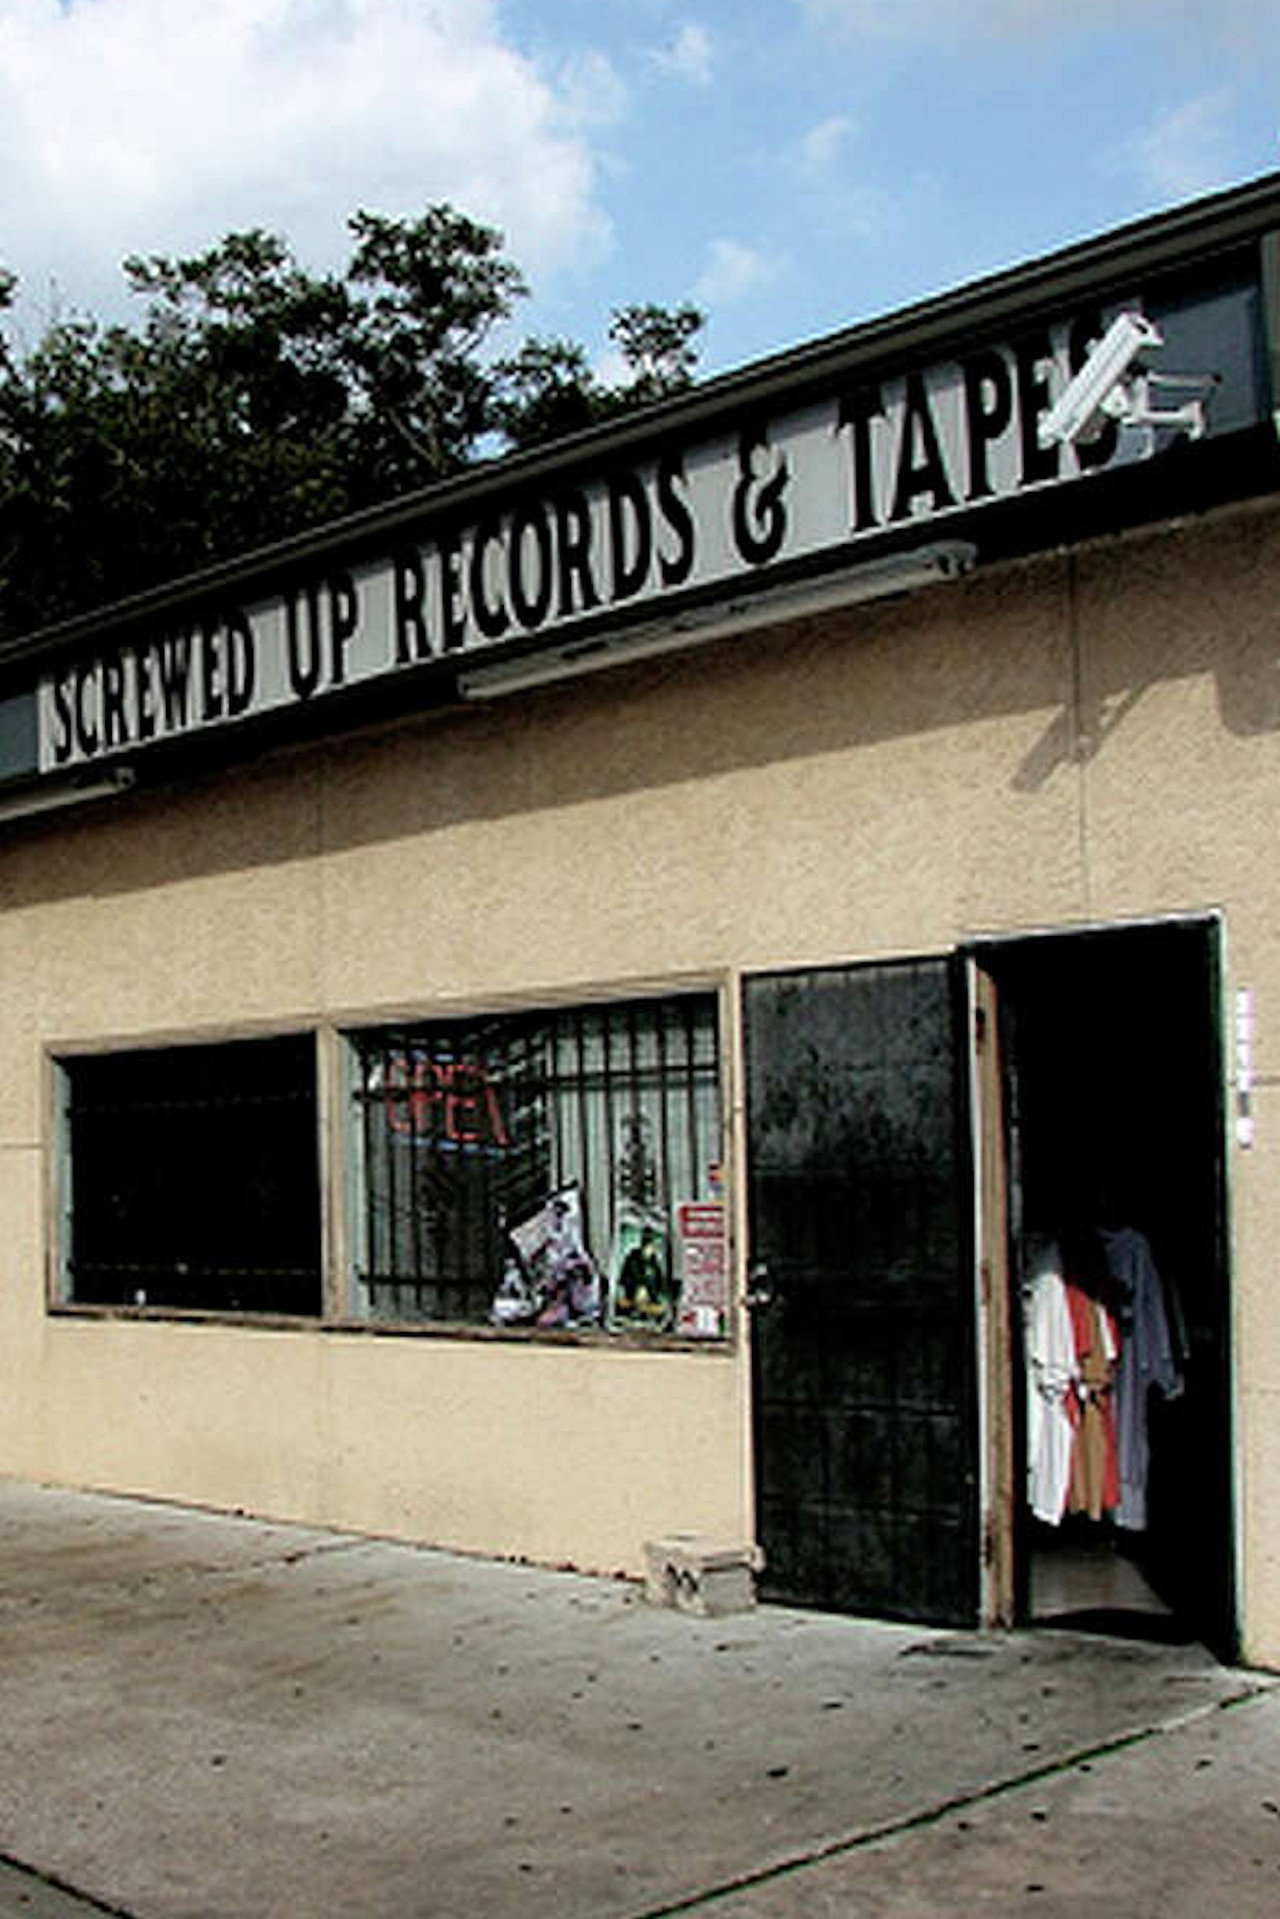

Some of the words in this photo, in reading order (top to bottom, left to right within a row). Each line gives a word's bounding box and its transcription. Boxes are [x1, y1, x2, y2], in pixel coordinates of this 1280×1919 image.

[54, 612, 253, 763] SCREWED
[288, 574, 358, 699] UP
[395, 453, 693, 664] RECORDS
[734, 428, 790, 563] &
